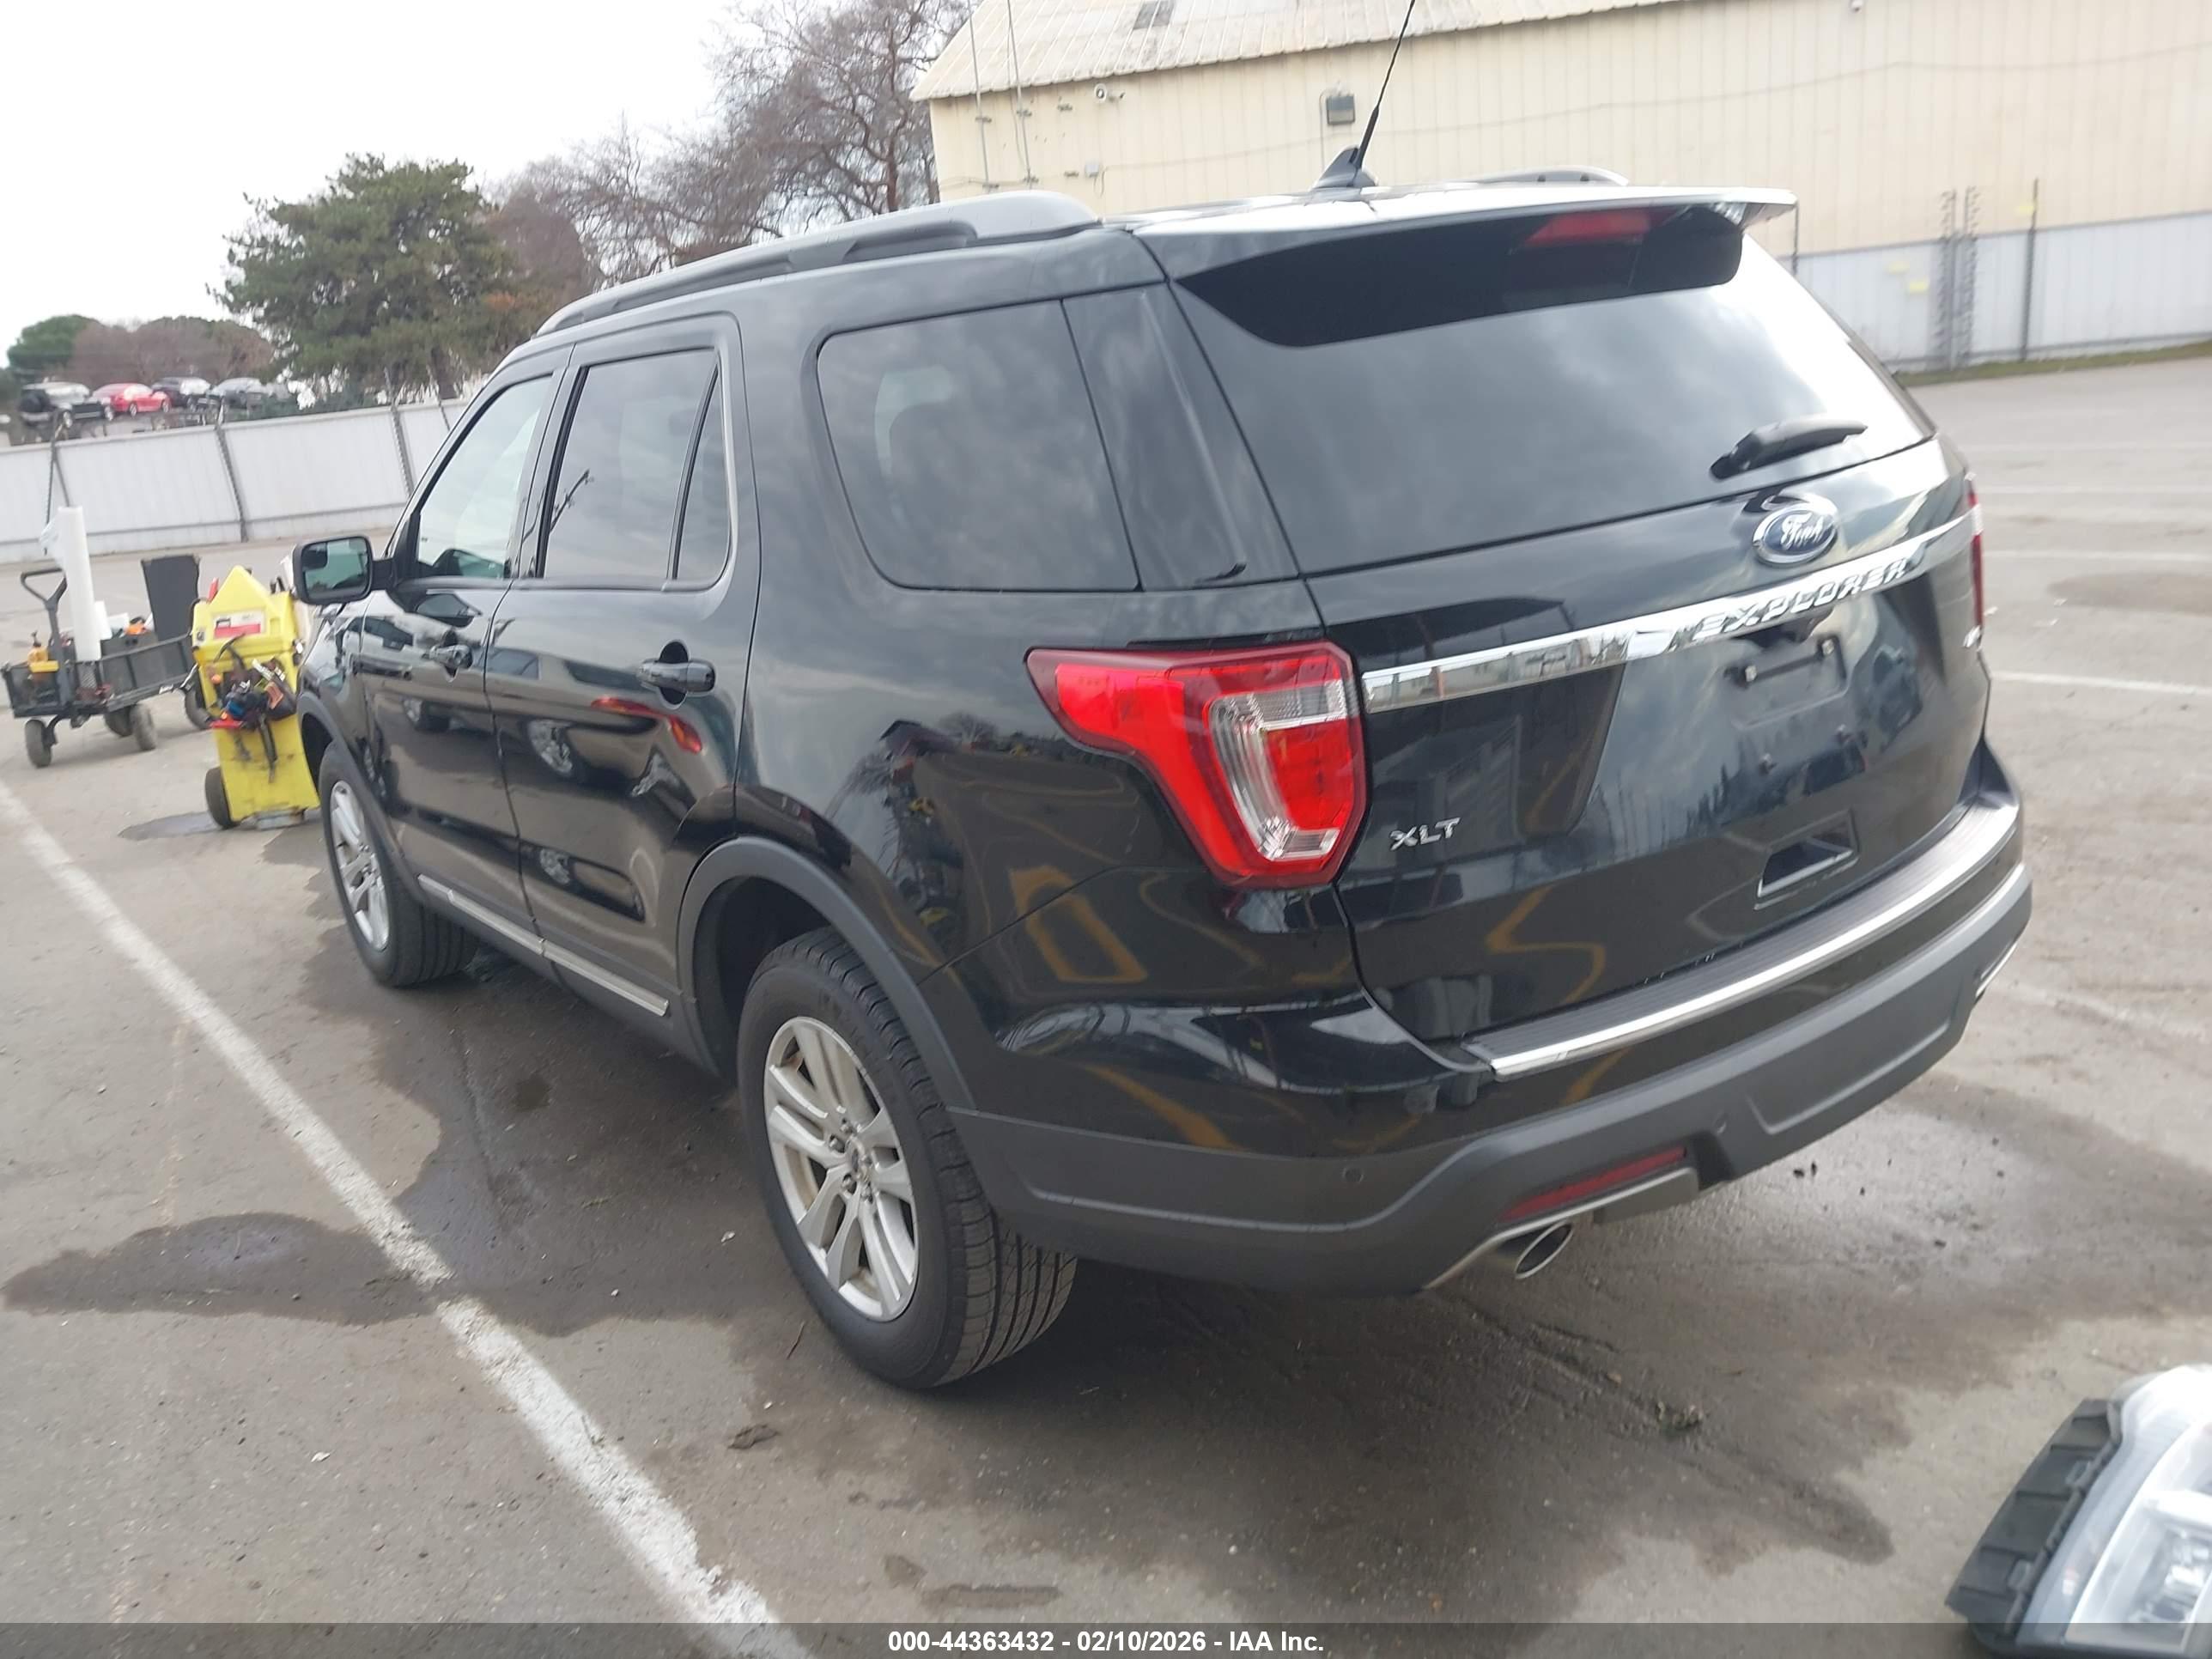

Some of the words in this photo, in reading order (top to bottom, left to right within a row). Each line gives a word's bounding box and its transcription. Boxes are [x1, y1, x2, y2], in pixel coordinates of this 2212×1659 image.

[1780, 513, 1825, 550] Ford
[1692, 556, 1908, 641] EXPLORER
[1389, 817, 1461, 851] XLT
